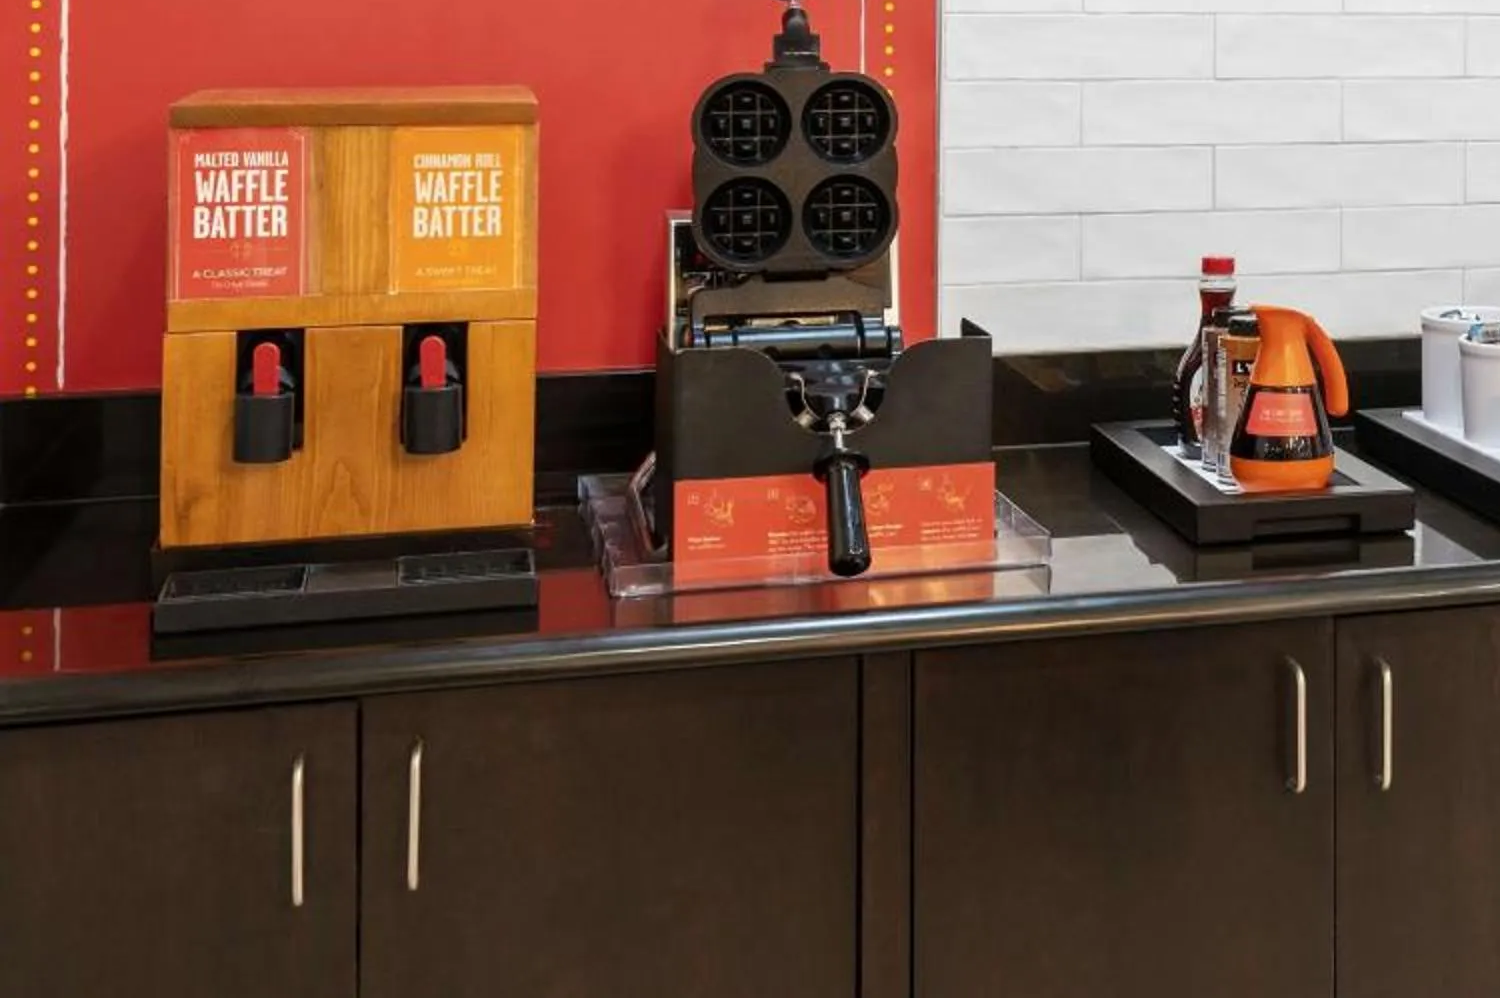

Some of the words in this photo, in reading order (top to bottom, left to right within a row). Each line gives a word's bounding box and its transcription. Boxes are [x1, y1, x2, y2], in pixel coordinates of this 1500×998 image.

[194, 152, 239, 167] MALTED
[244, 150, 288, 167] VANILLA
[195, 169, 288, 202] WAFFLE
[414, 170, 503, 203] WAFFLE
[194, 205, 287, 238] BATTER
[413, 205, 502, 238] BATTER
